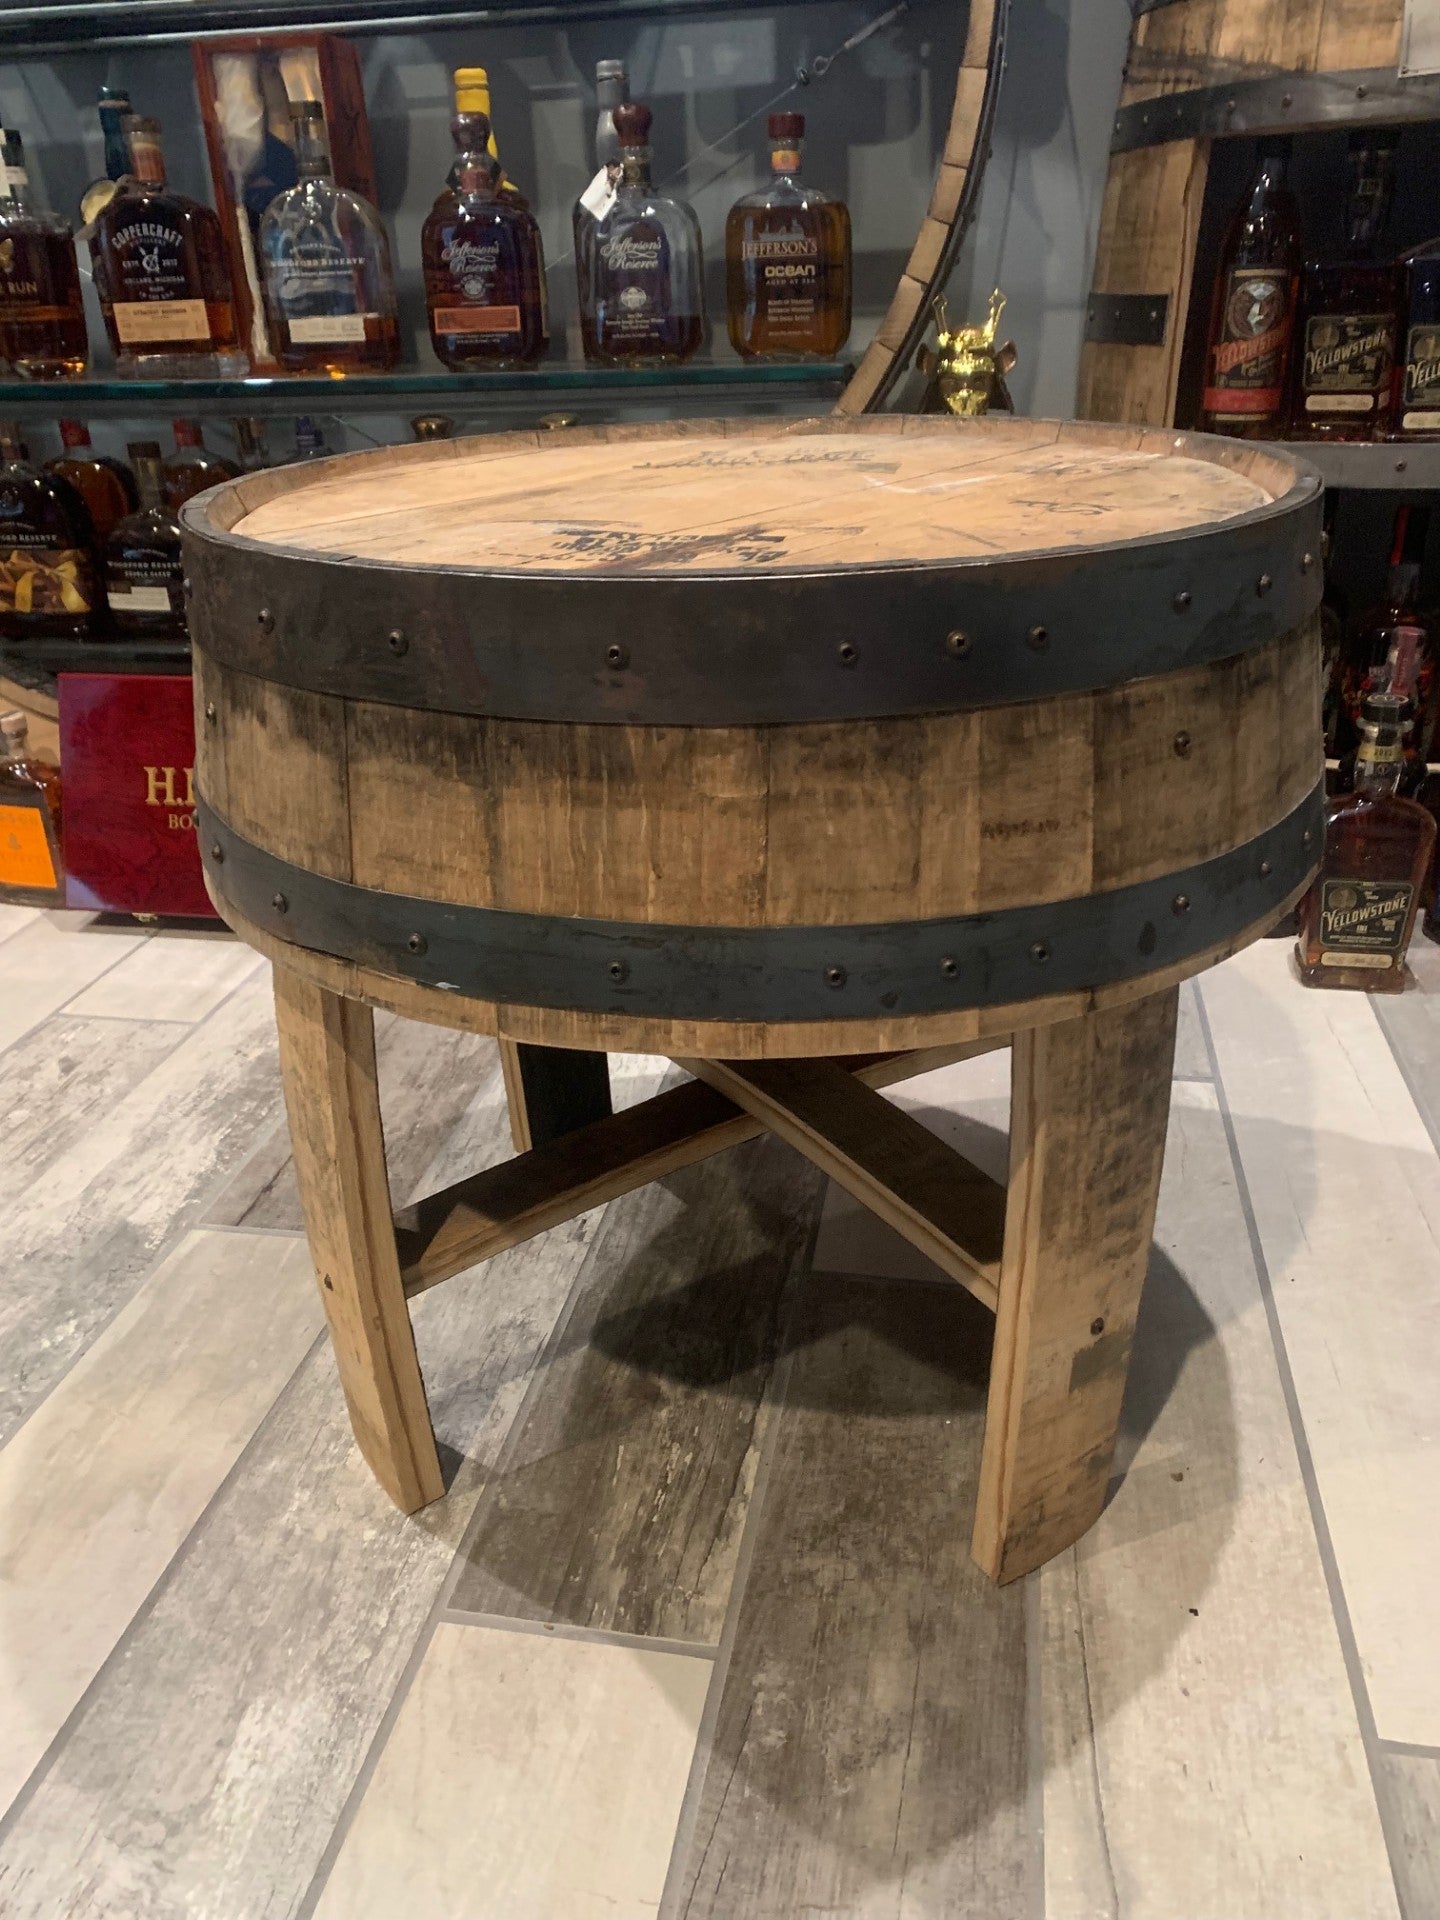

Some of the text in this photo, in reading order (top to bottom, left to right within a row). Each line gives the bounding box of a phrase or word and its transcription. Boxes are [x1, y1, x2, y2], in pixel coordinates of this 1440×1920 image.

[111, 222, 183, 250] COPPERCRAFT
[600, 235, 662, 258] Jefferson's
[441, 238, 500, 261] Jefferson's
[742, 238, 818, 260] JEFFERSON'S
[321, 257, 364, 265] RESERVE
[449, 256, 498, 274] Reserve
[608, 253, 659, 271] Reserve
[1306, 328, 1387, 375] YELLOWSTONE
[1322, 895, 1408, 933] YELLOWSTONE
